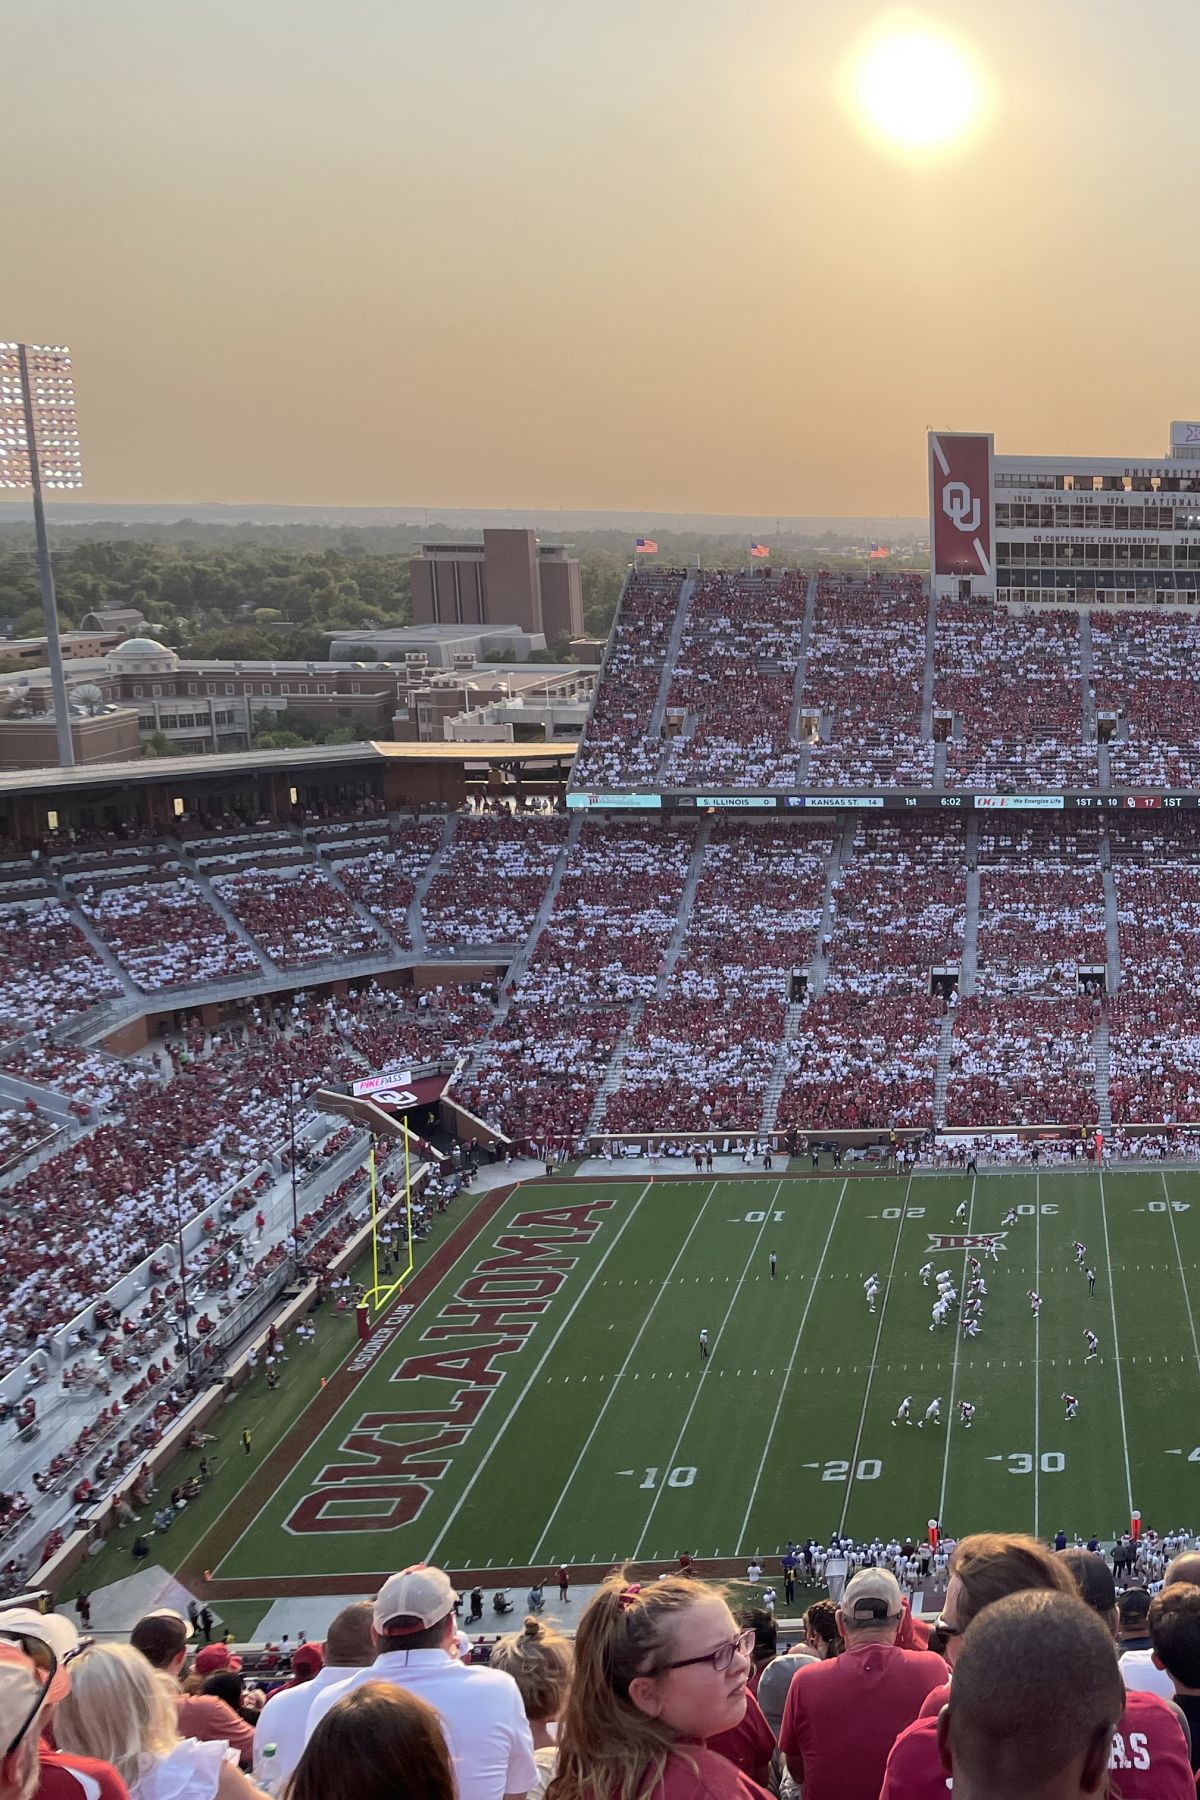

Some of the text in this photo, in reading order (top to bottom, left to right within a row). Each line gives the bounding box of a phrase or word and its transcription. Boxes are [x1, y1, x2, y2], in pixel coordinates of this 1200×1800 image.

[1124, 468, 1200, 479] UNIVERSITY
[942, 481, 981, 532] OU
[1143, 498, 1199, 507] NATIONAL
[905, 797, 917, 806] 1st
[941, 797, 961, 806] 6:02
[1076, 798, 1092, 806] 1ST
[1107, 798, 1118, 806] 10
[1144, 798, 1155, 806] 17
[1163, 797, 1182, 806] 1ST
[881, 1206, 926, 1219] 20
[1017, 1203, 1060, 1215] 30
[1147, 1201, 1190, 1213] 40
[744, 1210, 786, 1223] 10
[353, 1303, 414, 1362] SOONER CLUB
[282, 1198, 618, 1536] OKLAHOMA
[1007, 1452, 1066, 1473] 30
[821, 1459, 883, 1481] 20
[639, 1466, 698, 1489] 10
